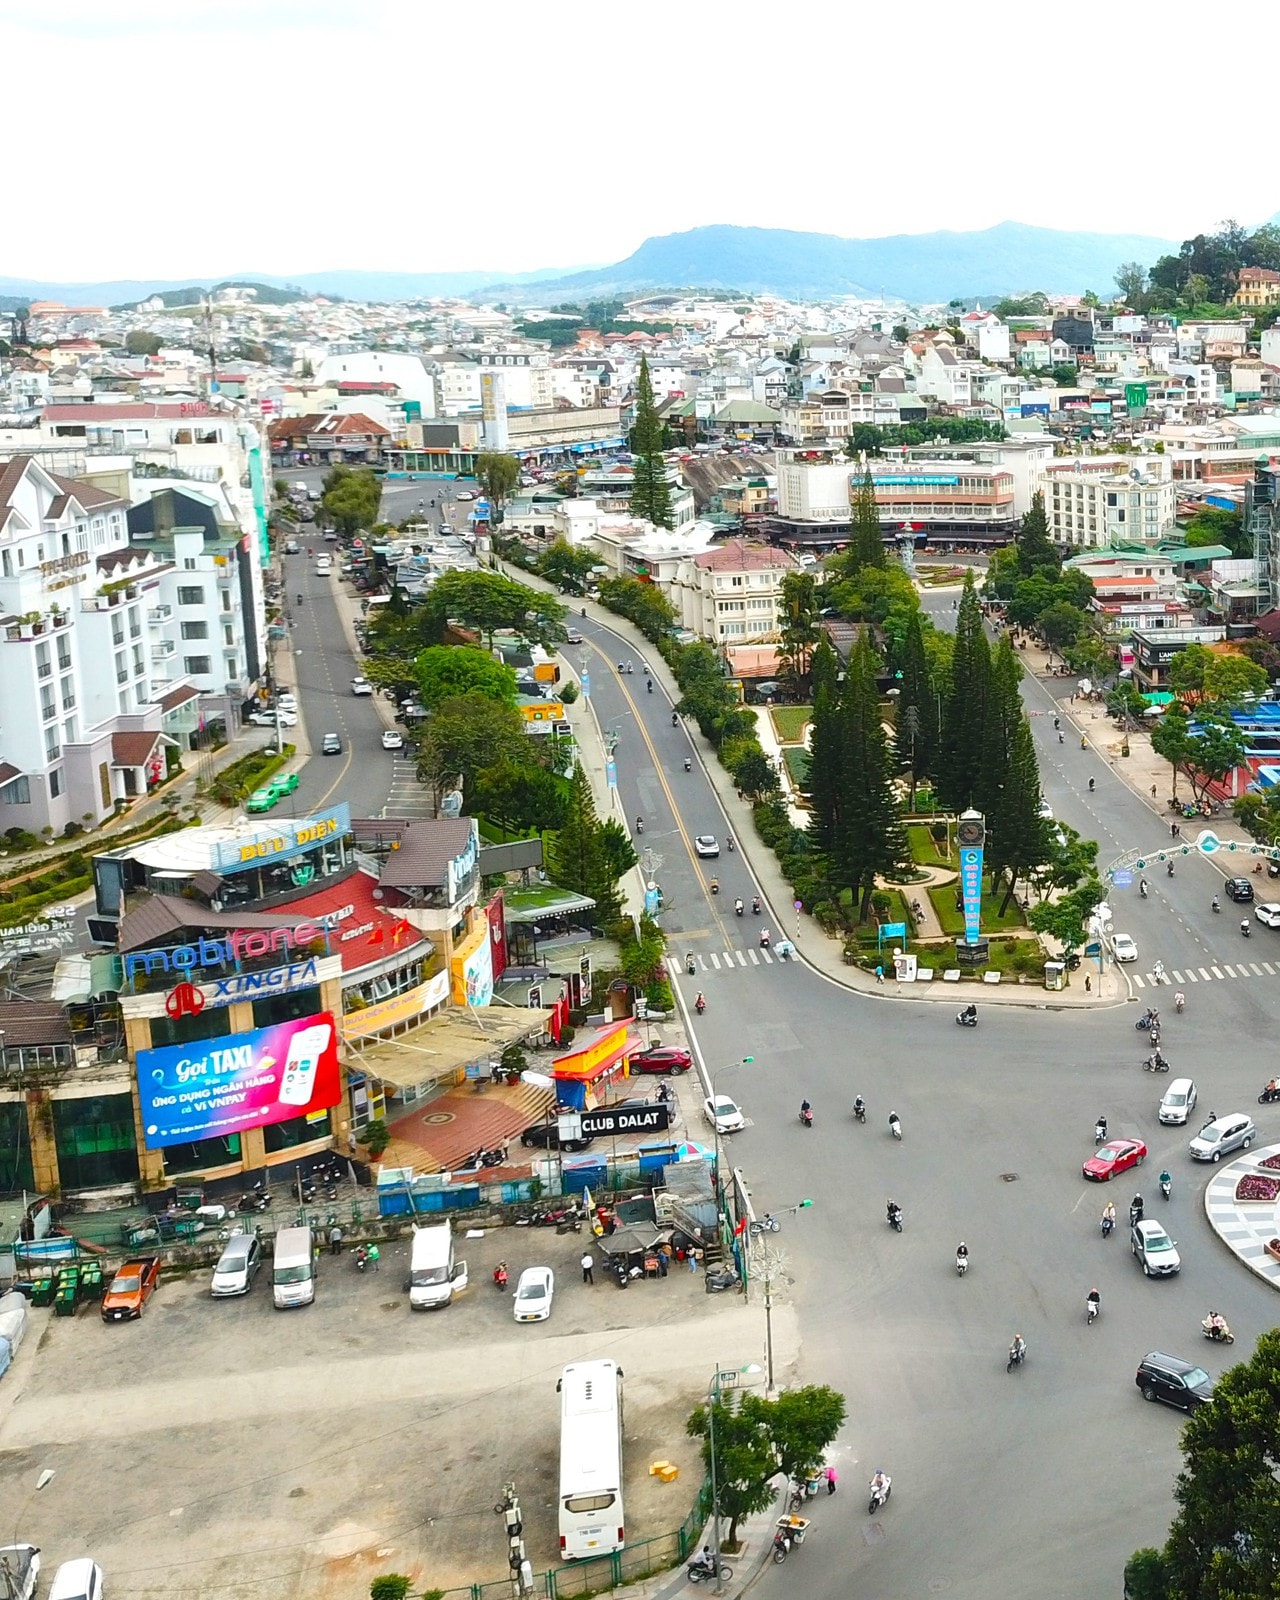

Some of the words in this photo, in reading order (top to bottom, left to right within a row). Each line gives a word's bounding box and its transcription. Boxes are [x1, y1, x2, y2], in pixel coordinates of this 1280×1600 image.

[240, 836, 287, 861] BƯU
[296, 817, 337, 845] ĐIỆN
[126, 921, 316, 977] mobifone
[213, 960, 318, 998] XINGFA
[175, 1056, 208, 1083] Gọi
[210, 1044, 253, 1075] TAXI
[152, 1094, 177, 1108] ỨNG
[179, 1089, 211, 1105] DỤNG
[212, 1079, 244, 1096] NGÂN
[245, 1073, 276, 1090] HÀNG
[209, 1091, 248, 1109] VNPAY
[582, 1117, 615, 1132] CLUB
[618, 1112, 660, 1128] DALAT
